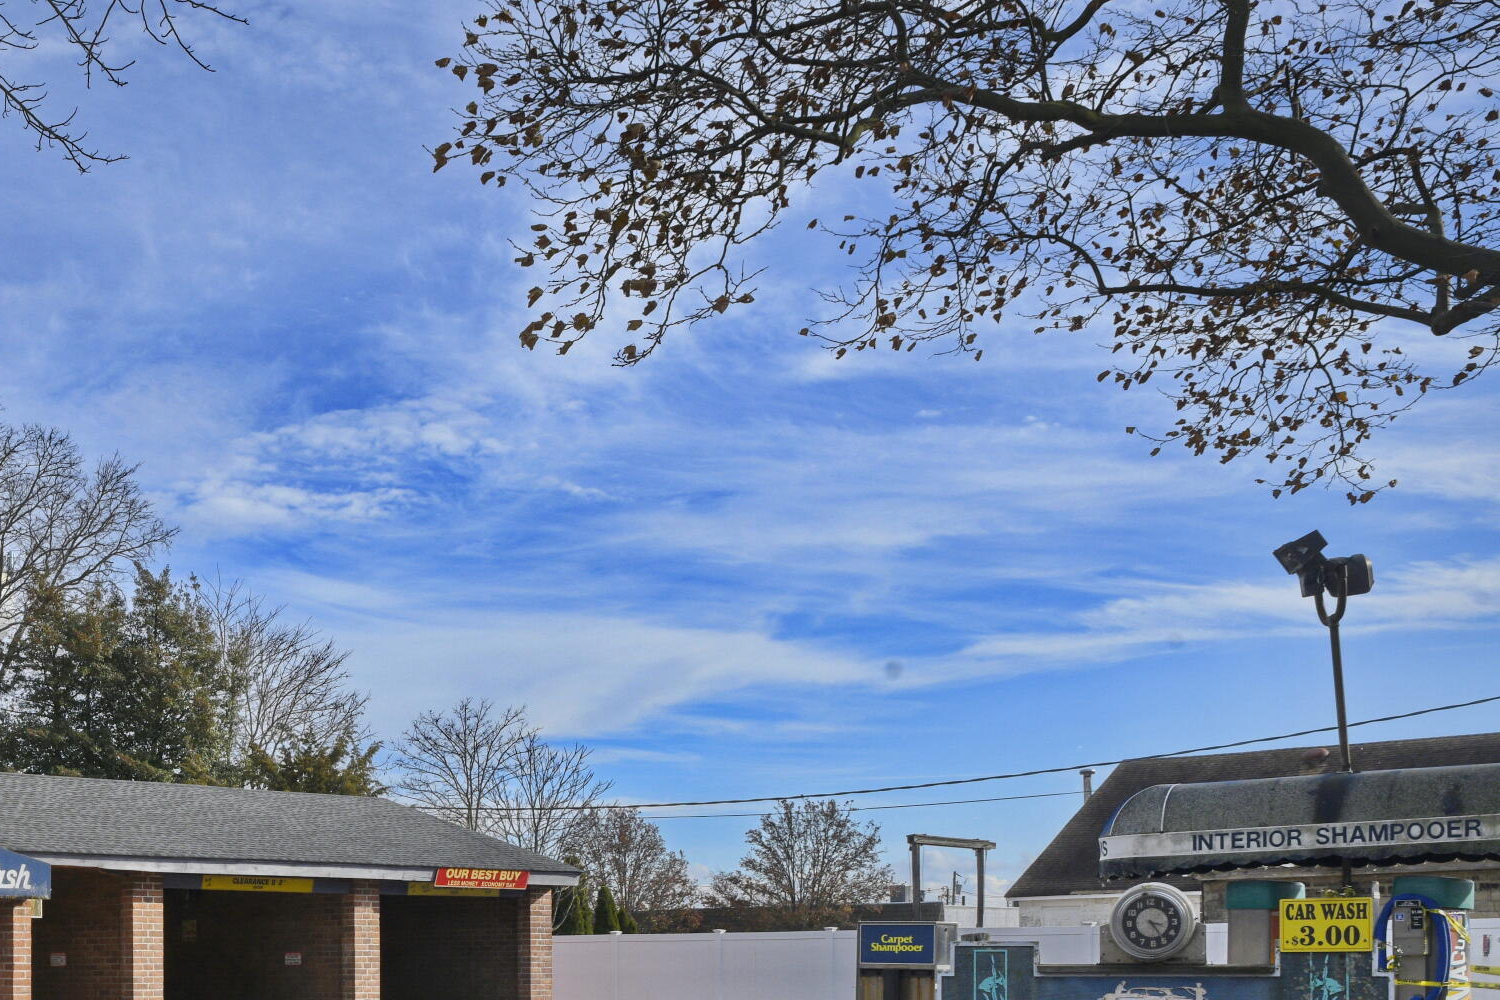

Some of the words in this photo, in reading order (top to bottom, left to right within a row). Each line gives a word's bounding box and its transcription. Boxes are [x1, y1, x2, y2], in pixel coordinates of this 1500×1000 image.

[1192, 829, 1302, 851] INTERIOR
[1316, 819, 1481, 845] SHAMPOOER
[446, 868, 469, 879] OUR
[471, 869, 498, 880] BEST
[500, 870, 521, 881] BUY
[1285, 904, 1316, 920] CAR
[1320, 903, 1368, 920] WASH
[881, 934, 913, 945] Carpet
[1292, 925, 1360, 946] $3.00
[870, 942, 924, 954] Shampooer
